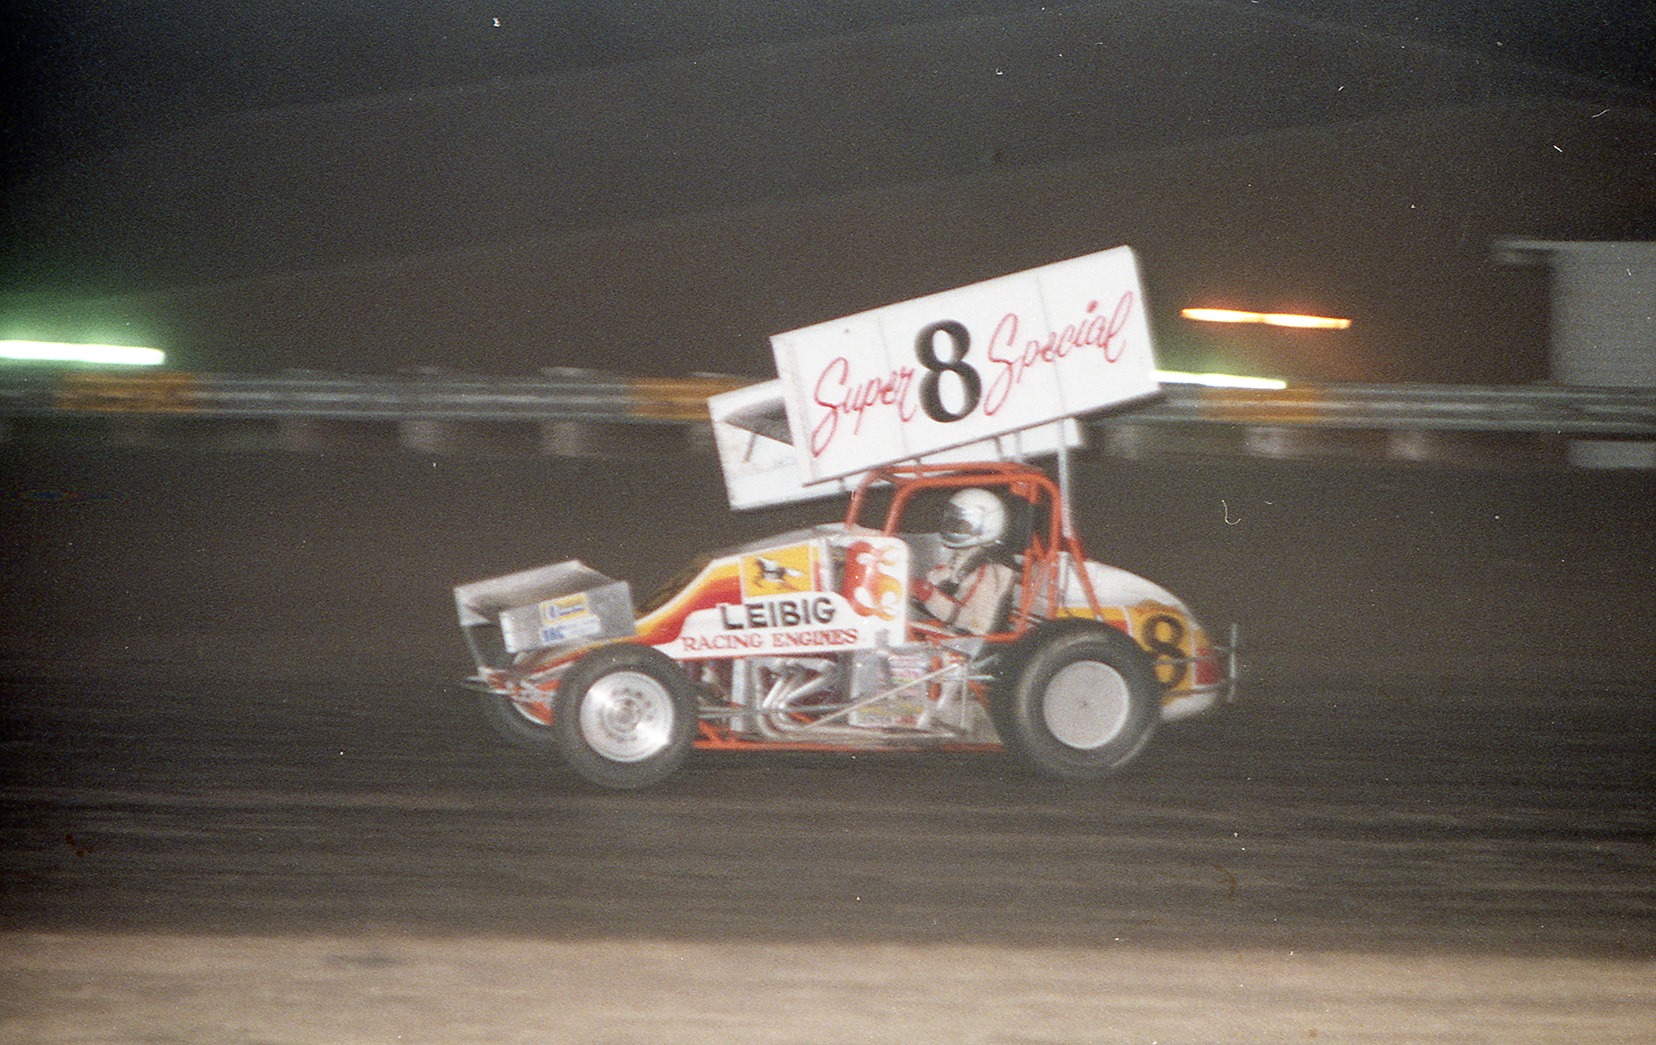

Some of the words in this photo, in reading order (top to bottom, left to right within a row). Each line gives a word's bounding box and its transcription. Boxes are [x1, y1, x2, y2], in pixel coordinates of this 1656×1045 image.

[811, 357, 917, 458] Super
[914, 319, 982, 423] 8
[983, 291, 1134, 416] Special
[682, 634, 762, 651] RACING
[772, 628, 858, 648] ENGINES
[719, 597, 836, 630] LEIBIG
[1142, 614, 1187, 690] 8
